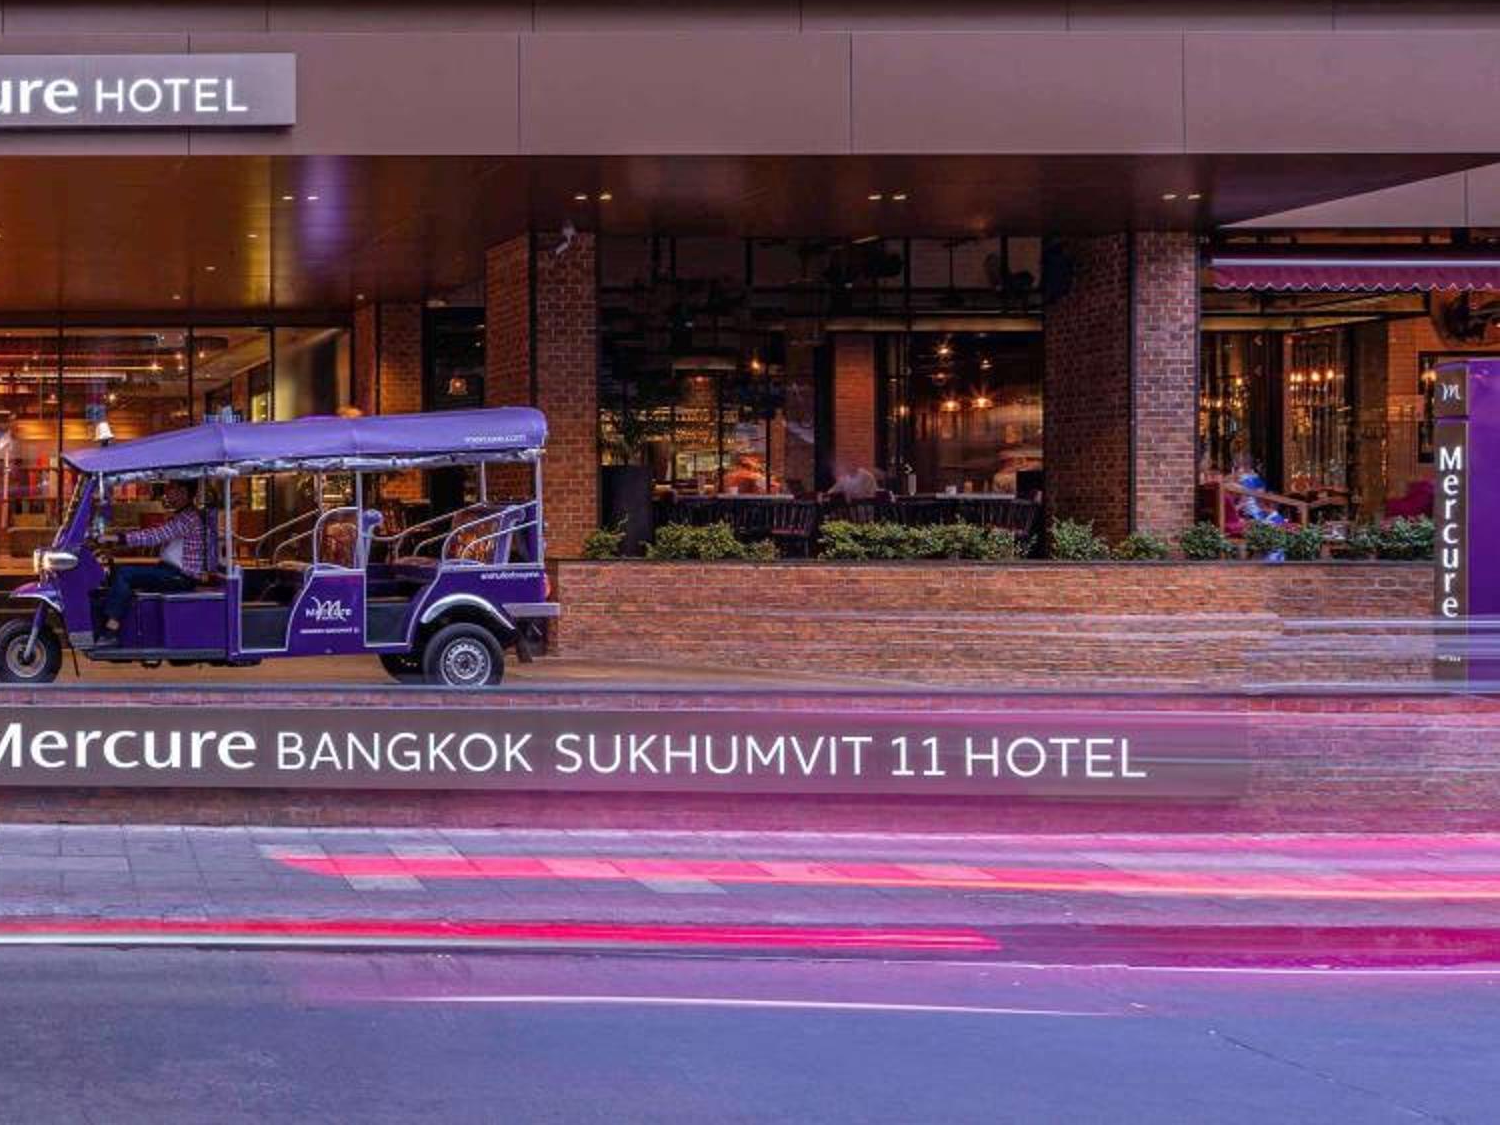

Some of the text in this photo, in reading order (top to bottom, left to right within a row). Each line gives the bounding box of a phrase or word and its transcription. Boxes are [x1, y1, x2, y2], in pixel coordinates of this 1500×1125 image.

[94, 77, 249, 113] HOTEL
[1438, 446, 1463, 618] Mercure
[277, 730, 533, 771] BANGKOK
[554, 732, 874, 775] SUKHUMVIT
[890, 735, 946, 776] 11
[965, 736, 1147, 777] HOTEL
